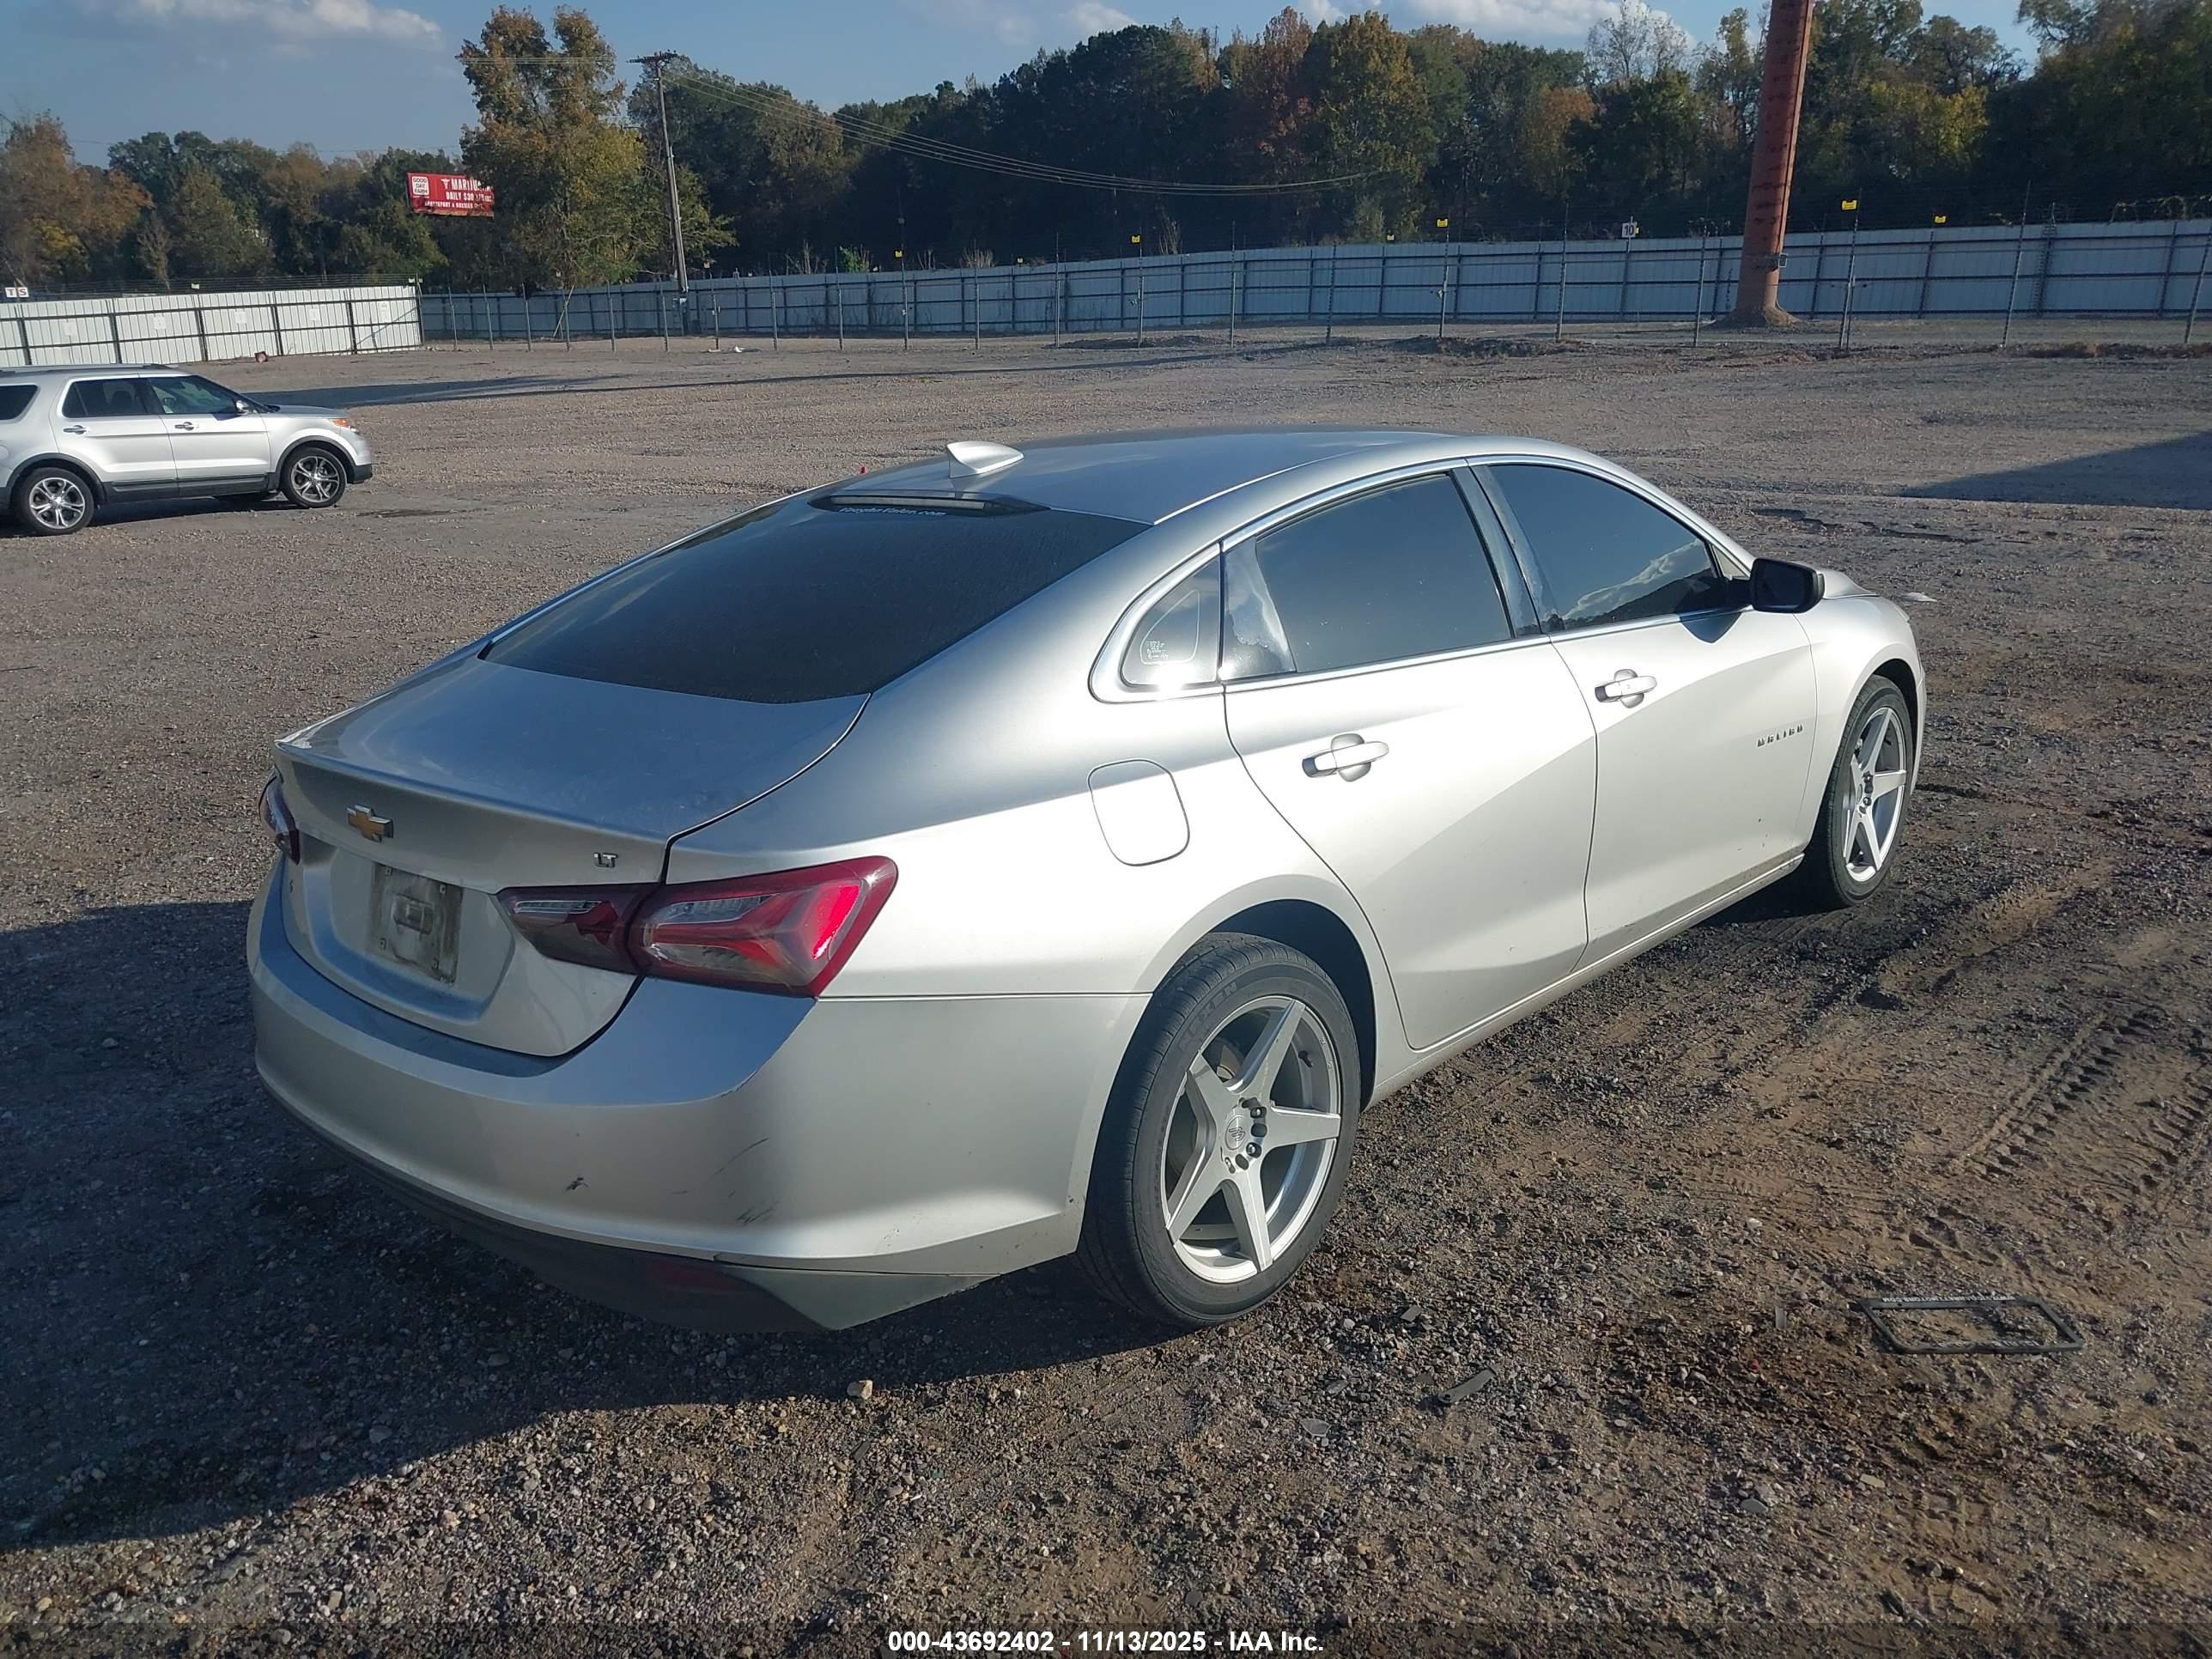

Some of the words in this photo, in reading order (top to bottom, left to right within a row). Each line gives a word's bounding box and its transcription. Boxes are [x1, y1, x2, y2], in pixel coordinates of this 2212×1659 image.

[446, 191, 462, 201] DAILY
[1625, 224, 1634, 236] 10
[1757, 723, 1803, 748] MALIBU
[593, 852, 619, 868] LT
